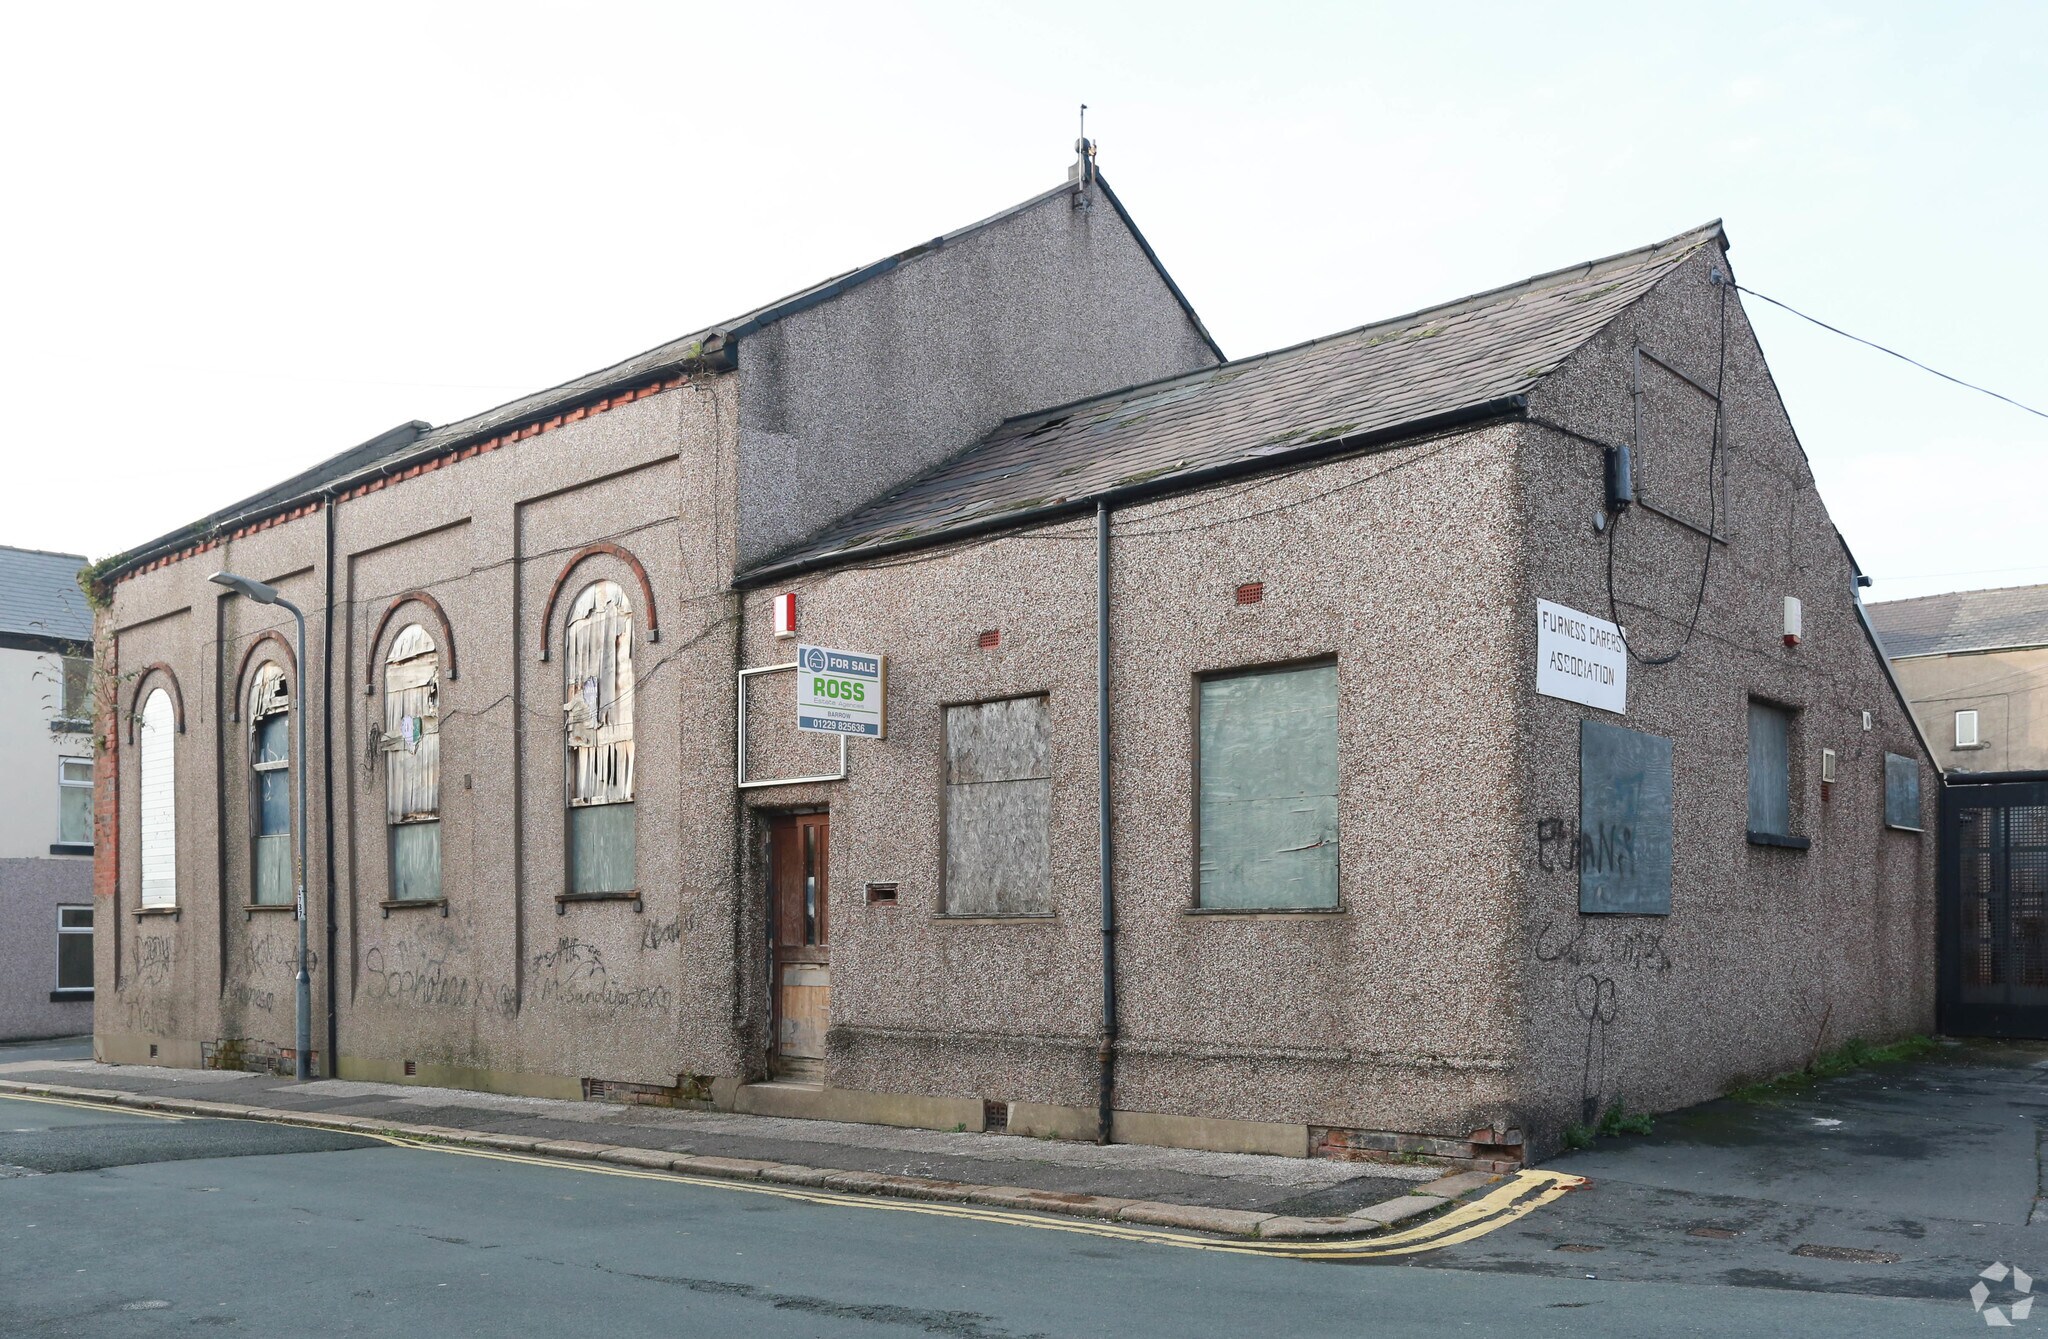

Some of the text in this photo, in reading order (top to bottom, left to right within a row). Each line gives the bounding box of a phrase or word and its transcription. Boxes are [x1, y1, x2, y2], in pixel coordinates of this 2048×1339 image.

[1542, 611, 1621, 653] FURNESS CARERS
[830, 658, 876, 673] FOR SALE
[1549, 650, 1615, 686] ASSOCIATION
[813, 677, 865, 702] ROSS
[813, 697, 836, 705] Estate
[827, 711, 851, 719] BARROW
[813, 719, 865, 733] 01229 825636
